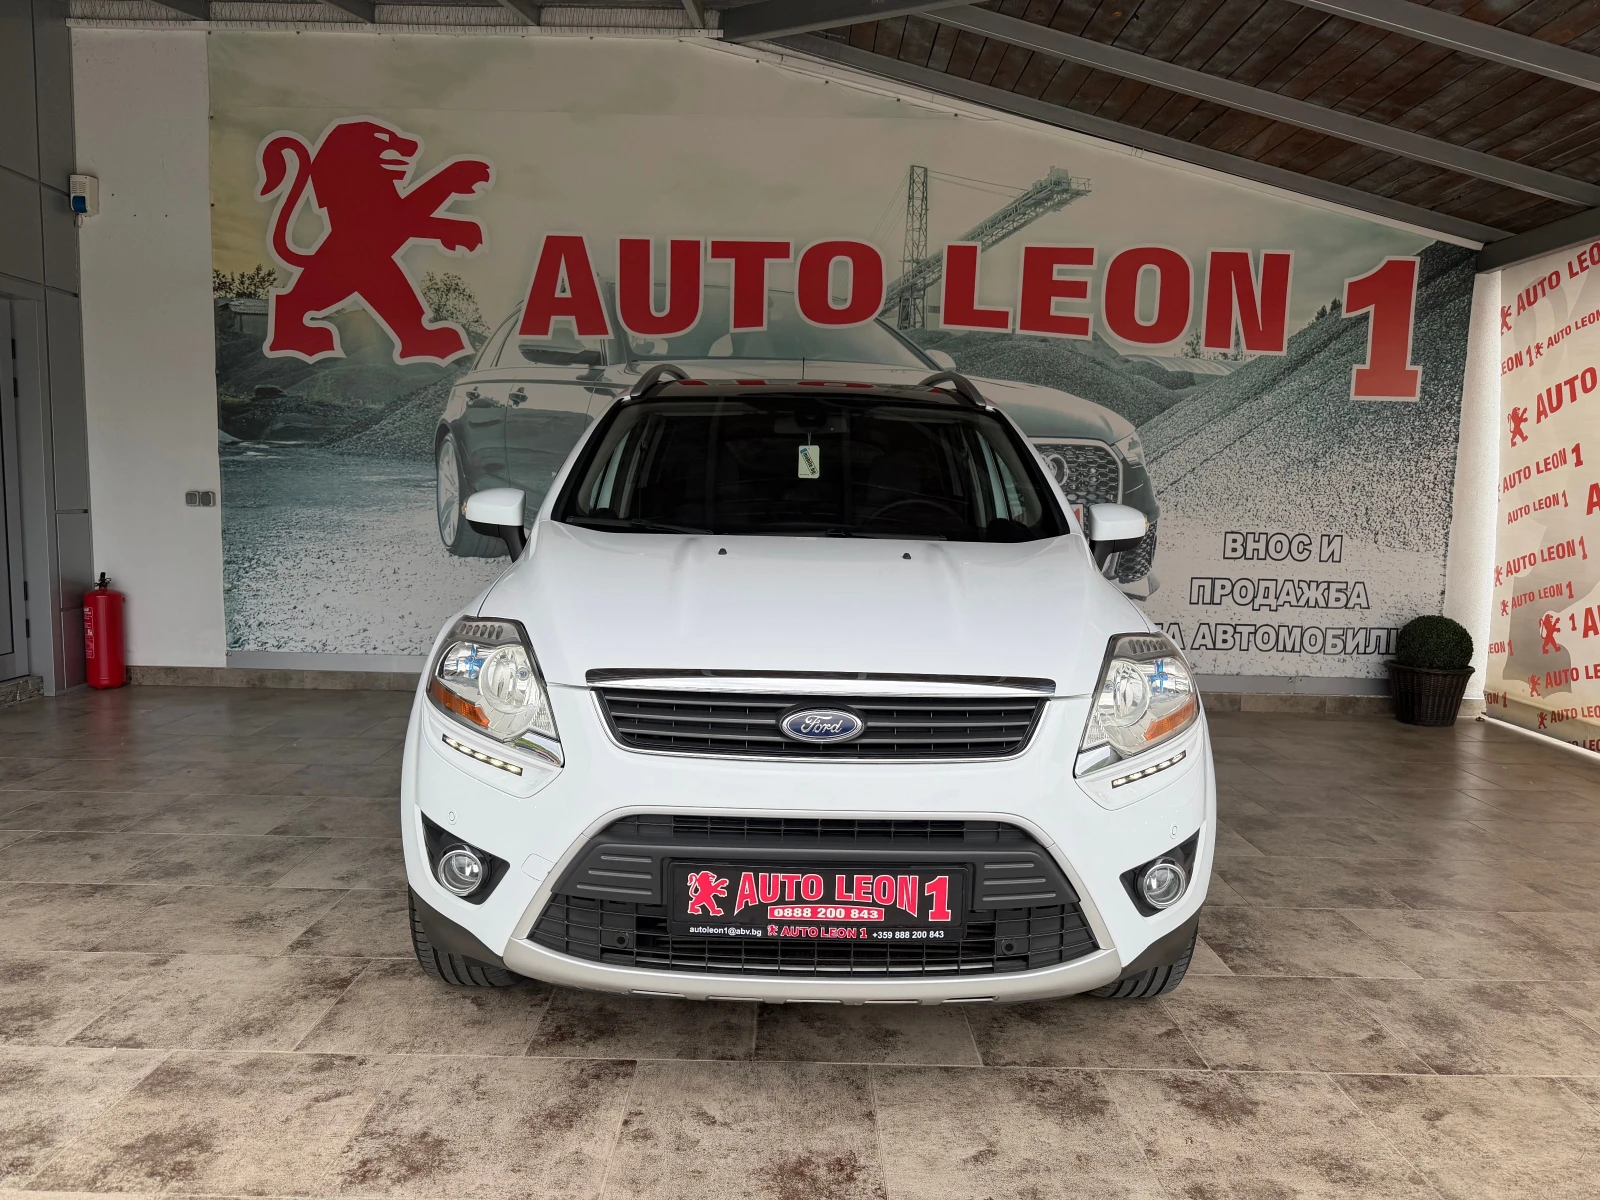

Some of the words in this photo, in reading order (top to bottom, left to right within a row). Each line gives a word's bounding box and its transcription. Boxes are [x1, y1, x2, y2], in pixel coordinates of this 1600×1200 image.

[1516, 270, 1561, 317] AUTO
[513, 232, 888, 341] AUTO
[939, 241, 1295, 357] LEON
[1340, 255, 1423, 401] 1
[1547, 325, 1572, 349] AUTO
[1500, 351, 1524, 377] EON
[1526, 345, 1534, 367] 1
[1536, 366, 1598, 424] AUTO
[1503, 465, 1532, 494] AUTO
[1535, 447, 1568, 475] LEON
[1571, 442, 1584, 468] 1
[1507, 504, 1531, 525] AUTO
[1533, 492, 1560, 512] LEON
[1561, 489, 1569, 508] 1
[1223, 531, 1312, 561] ВНОС
[1319, 534, 1343, 563] И
[1506, 552, 1537, 578] AUTO
[1540, 539, 1577, 563] LEON
[1578, 535, 1588, 560] 1
[1189, 577, 1370, 611] ПРОДАЖБА
[1511, 591, 1535, 609] AUTO
[1538, 582, 1563, 600] LEON
[1566, 580, 1575, 599] 1
[1569, 613, 1577, 631] 1
[1488, 641, 1506, 654] EON
[1507, 639, 1514, 656] 1
[1545, 667, 1579, 689] AUTO
[1502, 691, 1508, 708] 1
[800, 714, 843, 733] Ford
[1550, 707, 1578, 723] AUTO
[734, 872, 823, 916] AUTO
[835, 874, 919, 918] LEON
[925, 875, 951, 921] 1
[773, 908, 812, 918] 0888
[817, 908, 846, 919] 200
[850, 909, 879, 919] 843
[689, 926, 762, 937] autoleon1@abv.bg
[780, 926, 819, 937] AUTO
[820, 927, 857, 938] LEON
[859, 928, 868, 939] 1
[872, 931, 893, 939] +359
[894, 931, 910, 939] 888
[912, 931, 927, 939] 200
[928, 930, 944, 938] 843
